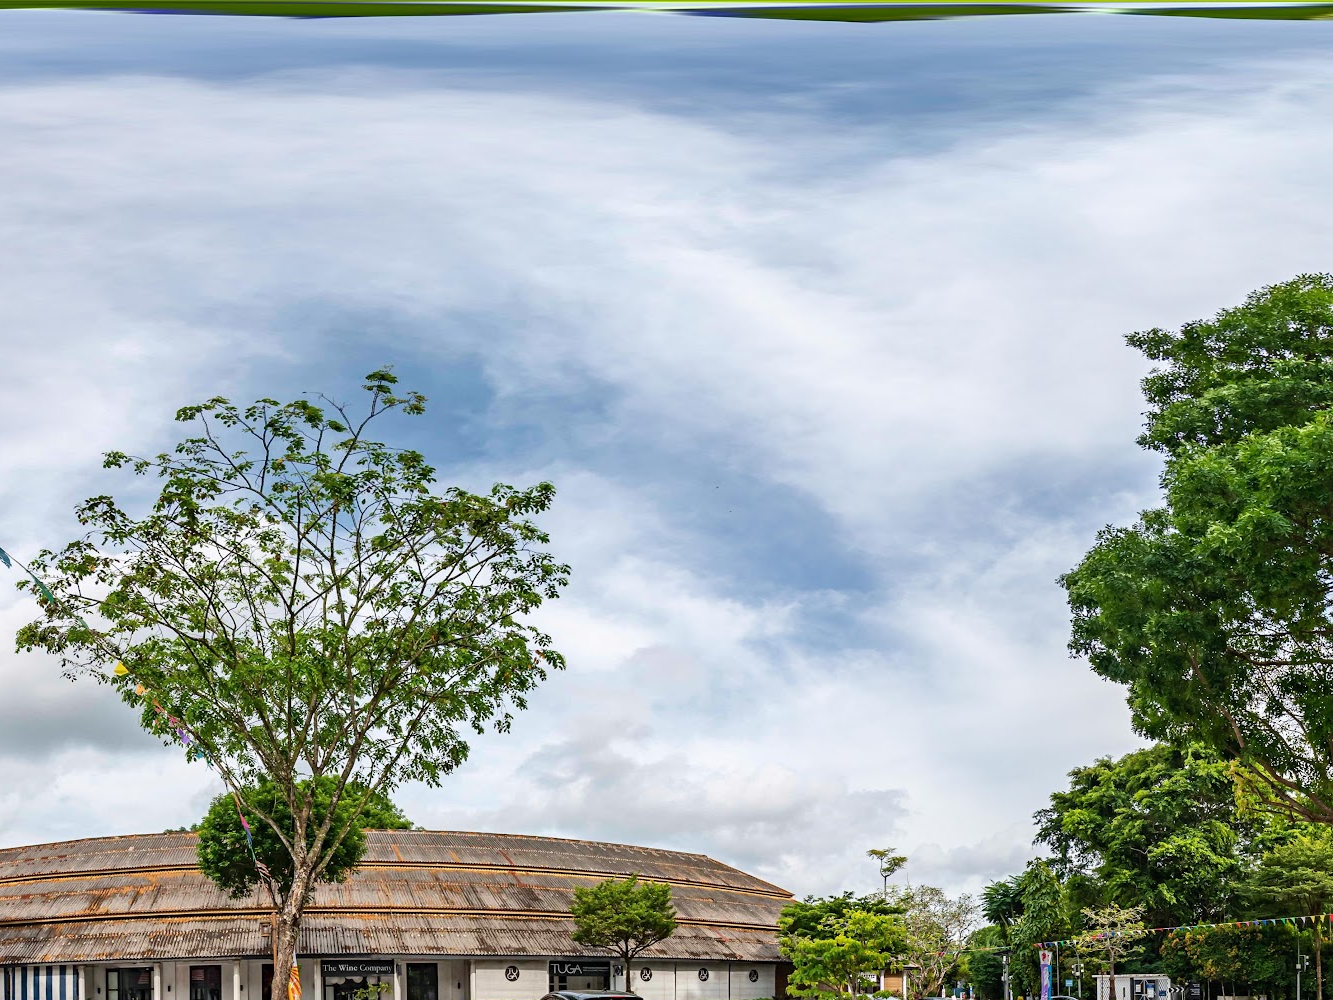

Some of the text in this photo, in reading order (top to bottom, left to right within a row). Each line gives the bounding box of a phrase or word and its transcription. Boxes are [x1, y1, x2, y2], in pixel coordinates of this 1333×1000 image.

[322, 964, 393, 973] The Wine Company
[550, 963, 583, 974] TUGA
